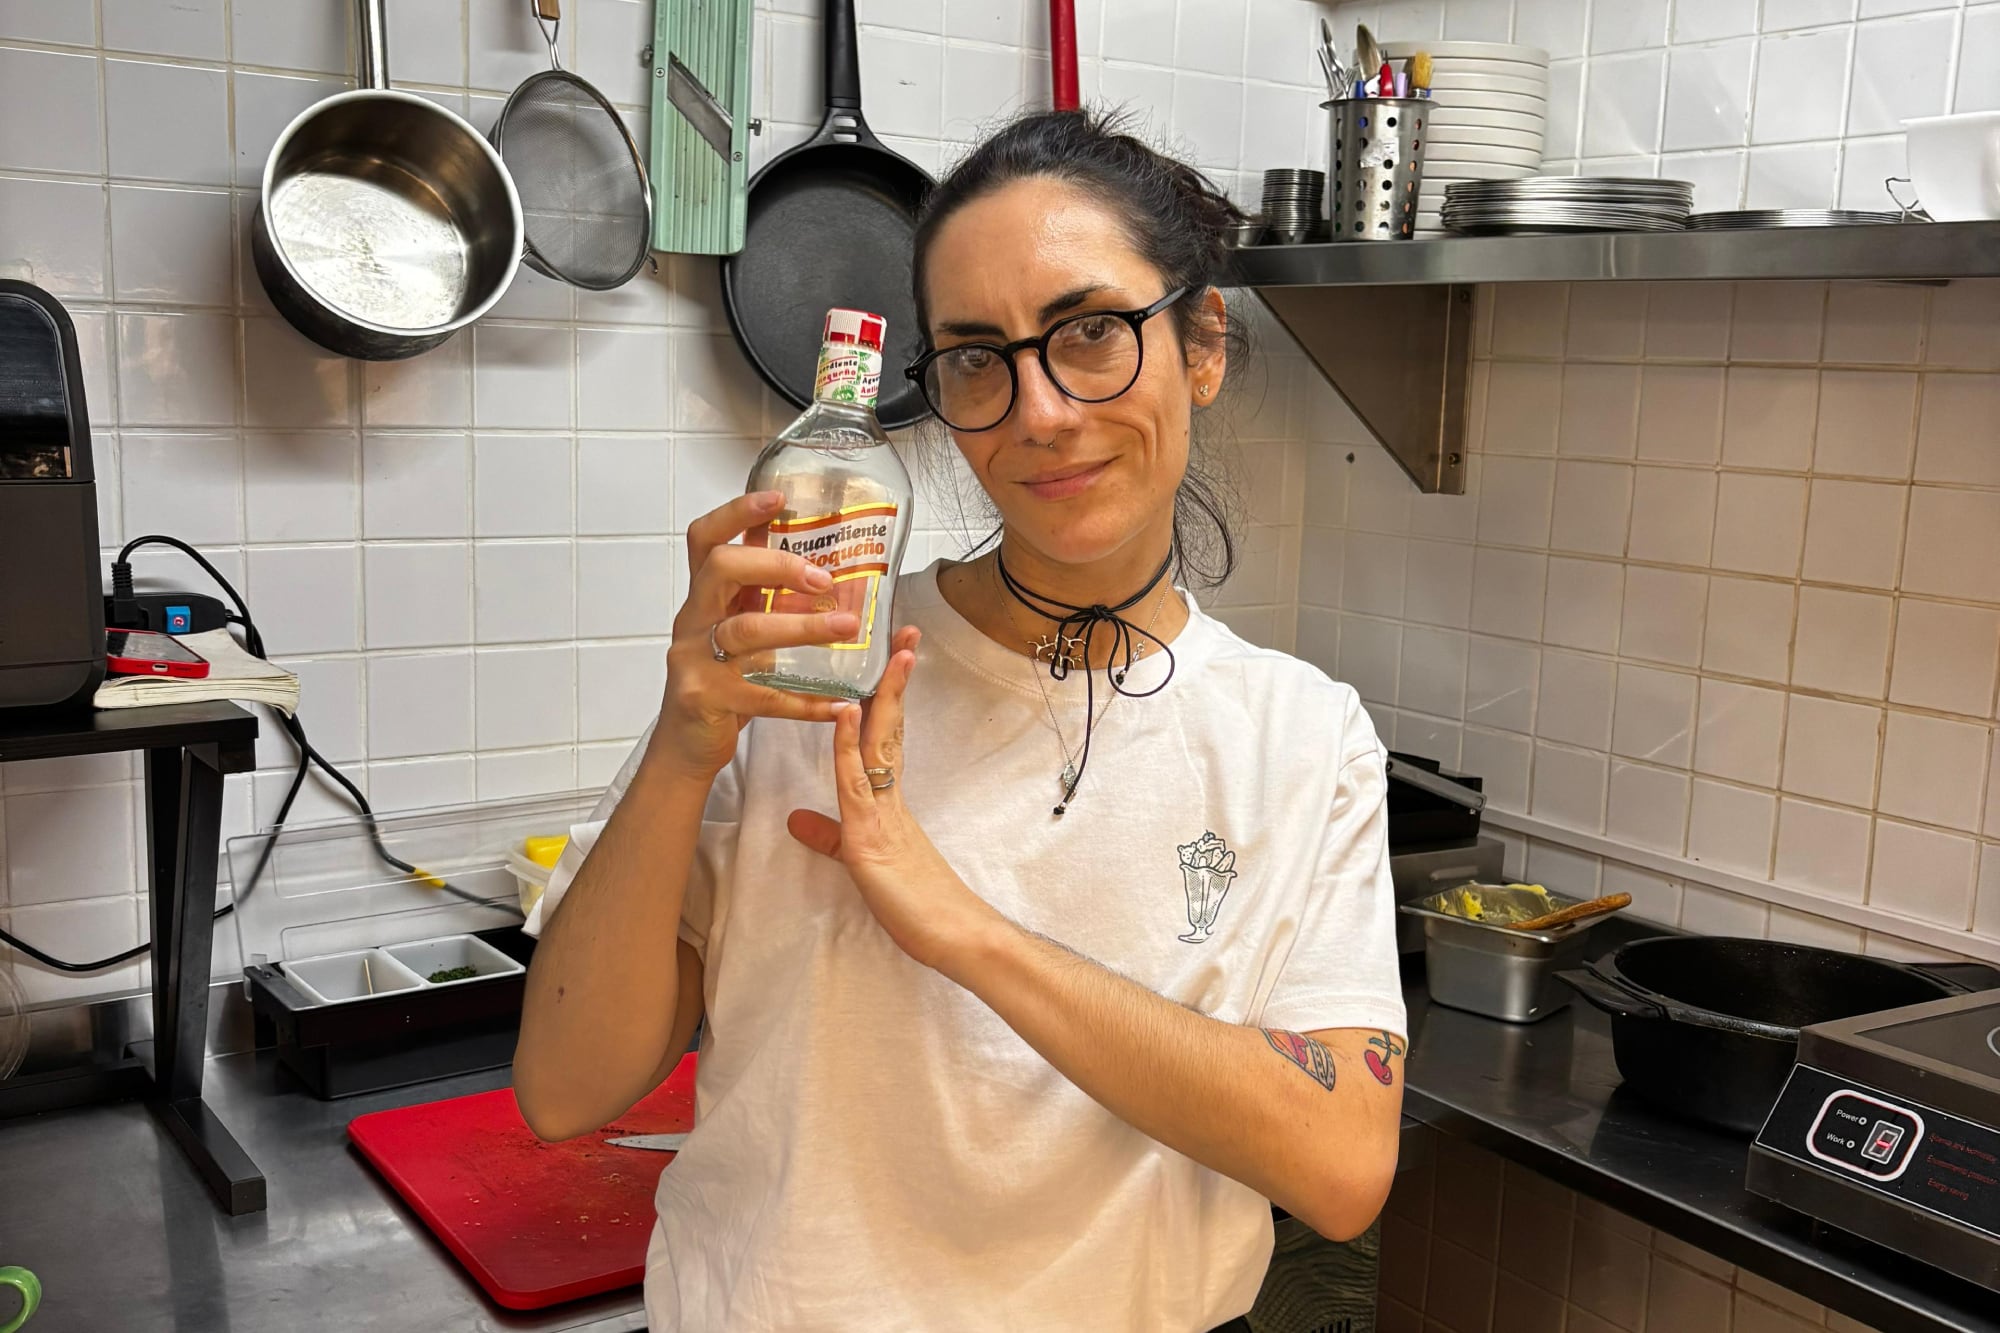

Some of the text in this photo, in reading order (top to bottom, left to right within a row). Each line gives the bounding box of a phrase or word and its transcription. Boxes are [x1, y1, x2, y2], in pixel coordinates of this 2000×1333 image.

[780, 524, 887, 555] Aguardiente
[803, 538, 885, 568] ioqueño
[1836, 1109, 1859, 1122] Power
[1827, 1132, 1845, 1145] Work
